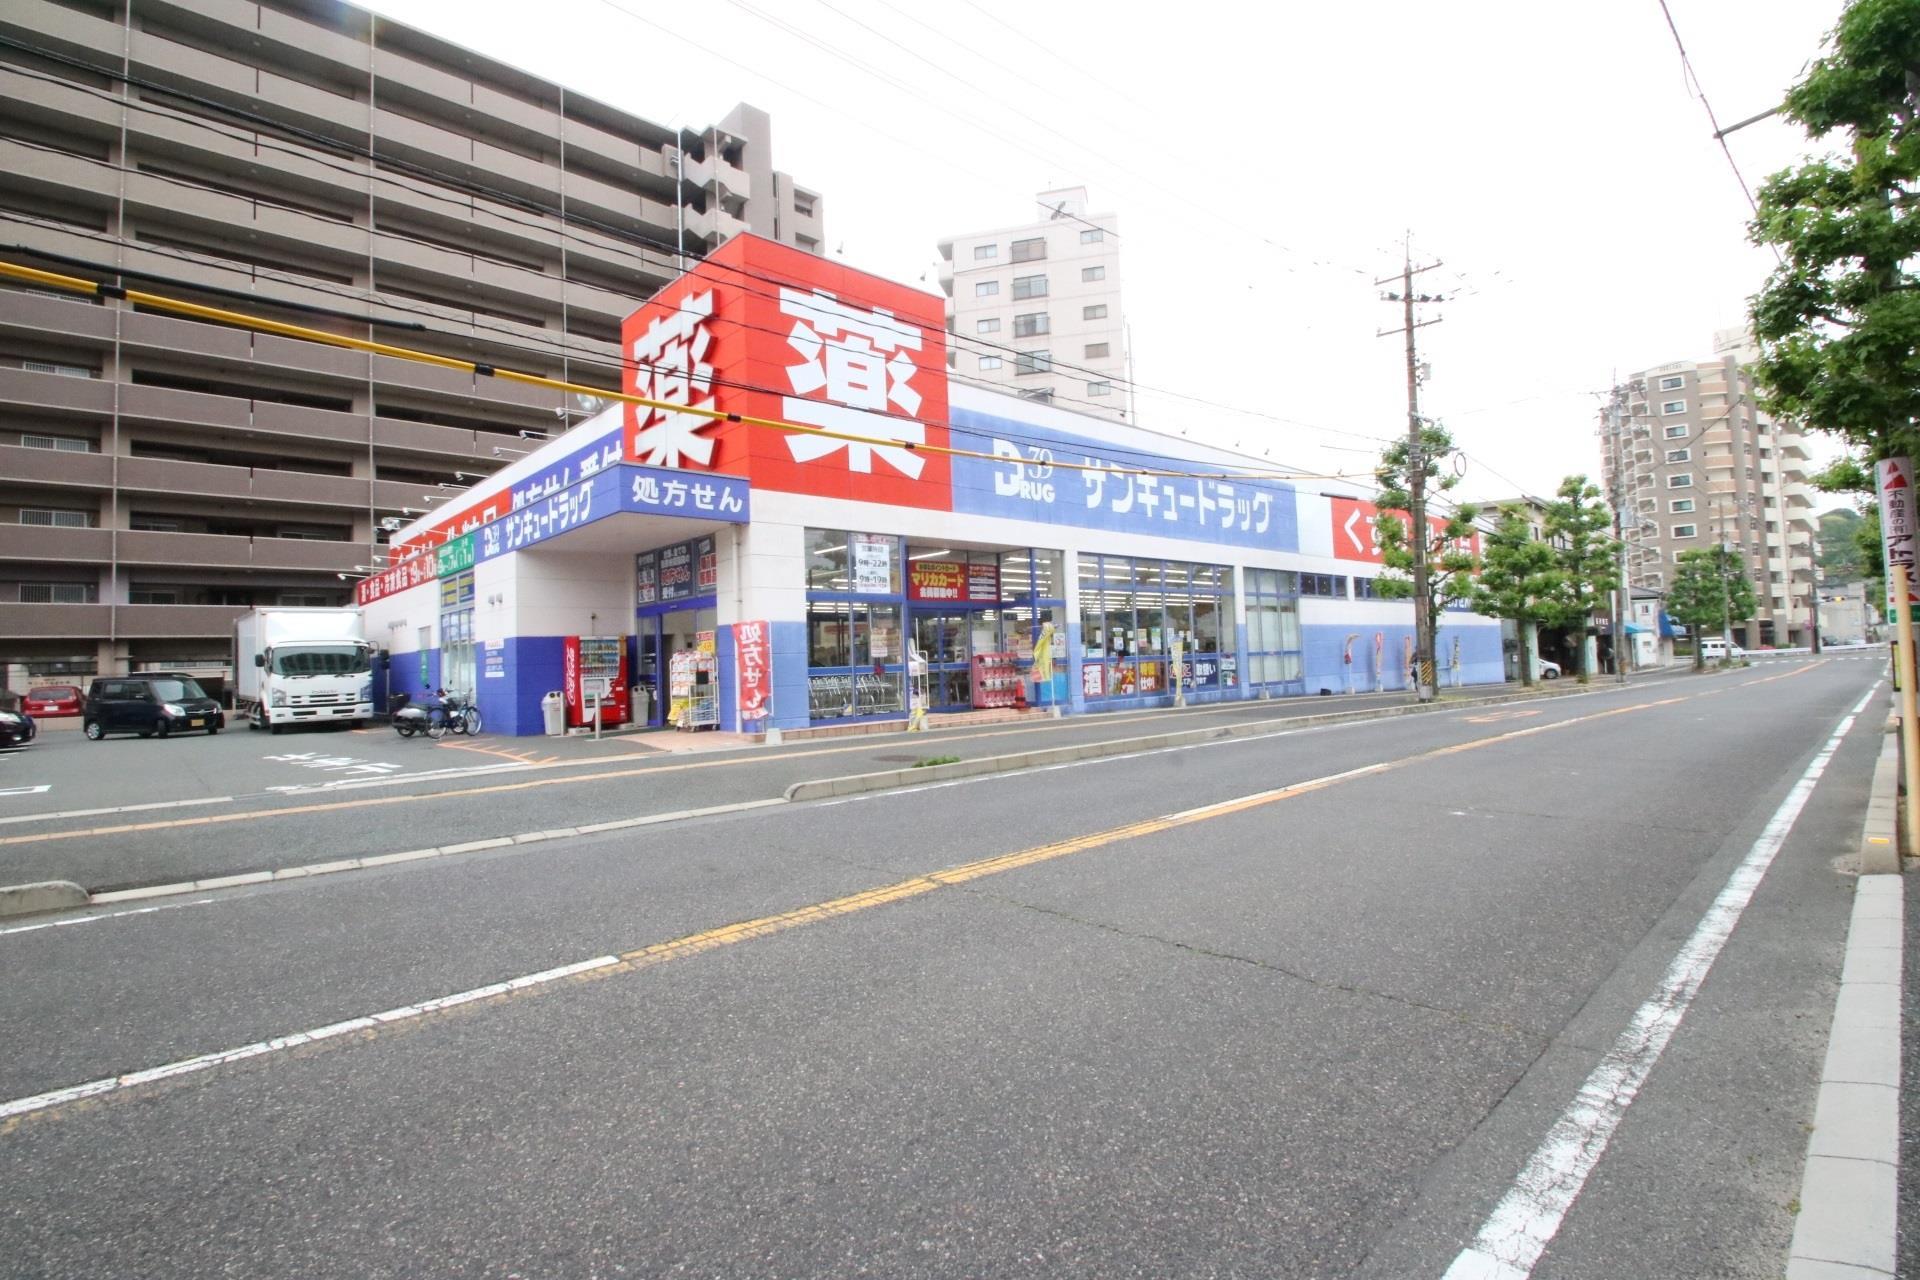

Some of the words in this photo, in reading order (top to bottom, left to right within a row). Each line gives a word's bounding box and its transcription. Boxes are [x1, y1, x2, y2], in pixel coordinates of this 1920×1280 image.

[633, 287, 714, 469] 薬
[779, 287, 926, 481] 薬
[632, 475, 743, 513] 処方せん
[1027, 447, 1054, 480] 39
[1081, 456, 1274, 534] サンキュードラッグ
[506, 480, 594, 549] サンキュードラッグ
[911, 572, 964, 588] マリカカード
